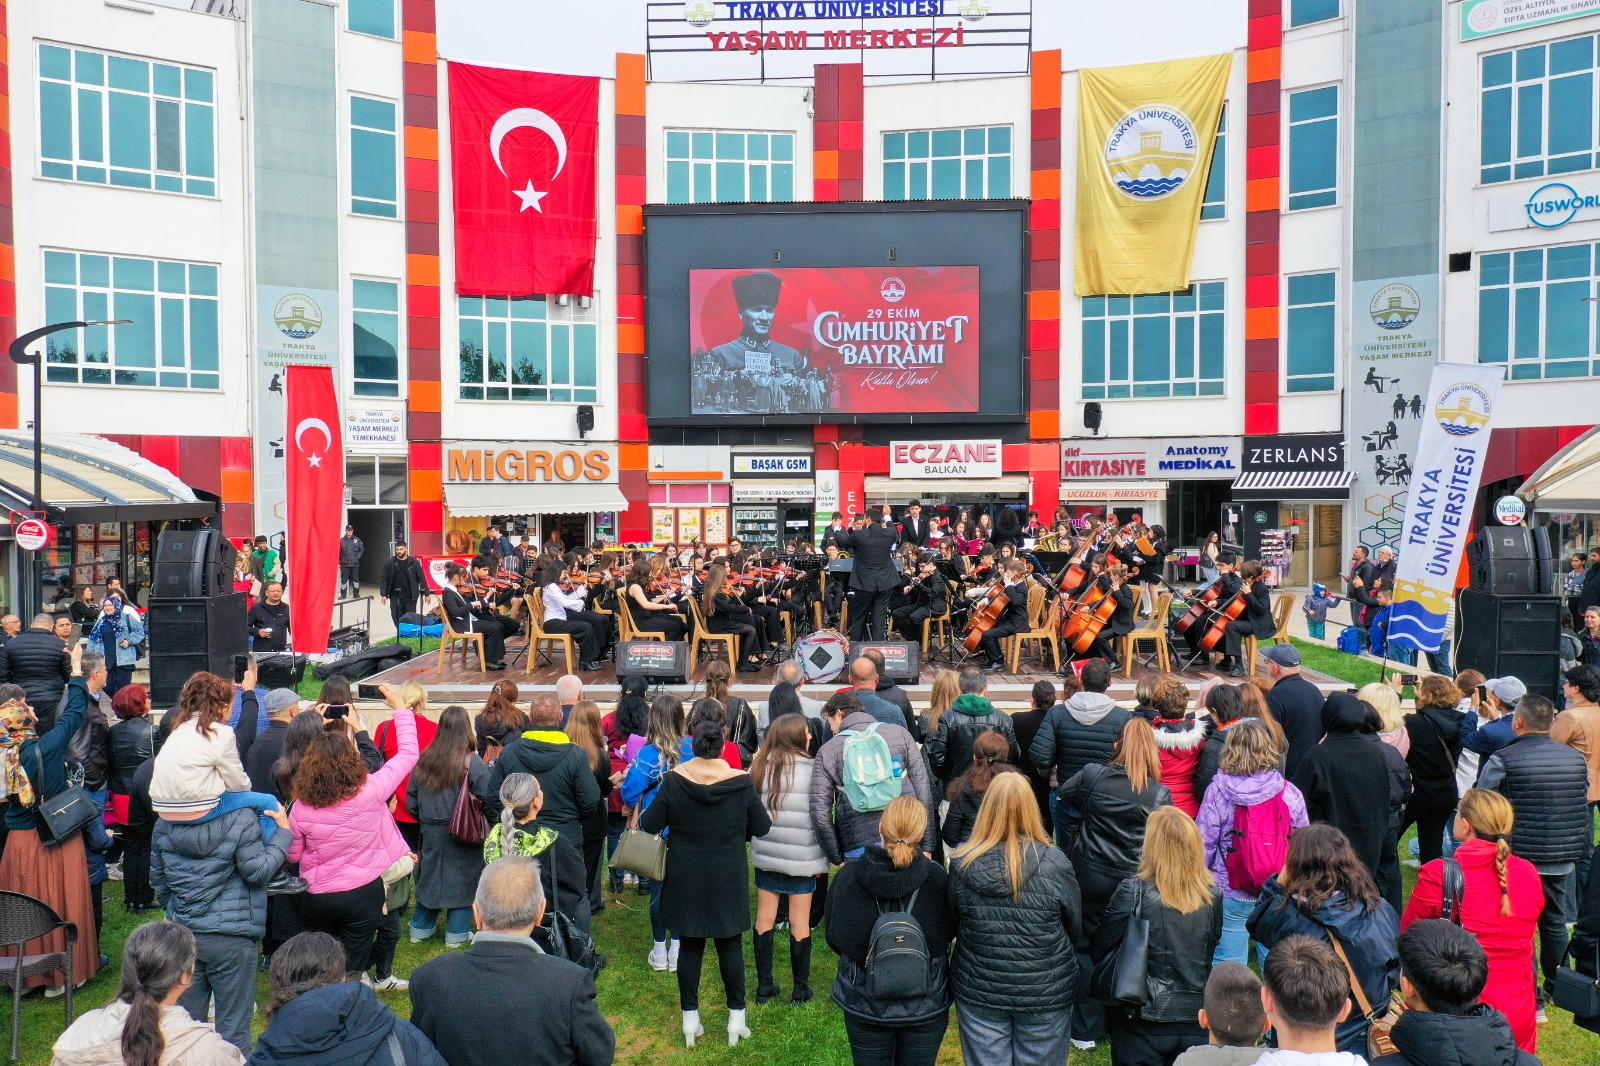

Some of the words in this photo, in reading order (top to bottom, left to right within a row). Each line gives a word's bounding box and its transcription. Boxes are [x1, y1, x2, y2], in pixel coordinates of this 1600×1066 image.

[726, 1, 807, 19] TRAKYA
[1503, 5, 1524, 15] ÖZEL
[1504, 15, 1525, 24] TIPTA
[1527, 5, 1569, 19] UZMANLIK
[706, 30, 807, 55] YAŞAM
[824, 22, 964, 49] MERKEZİ
[1109, 117, 1138, 152] TRAKYA
[1139, 109, 1195, 149] ÜNİVERSİTESİ
[1142, 138, 1160, 149] 1982
[867, 309, 883, 319] 29
[888, 306, 920, 319] EKİM
[1377, 333, 1412, 342] TRAKYA
[1364, 341, 1426, 352] ÜNİVERSİTESİ
[268, 350, 327, 360] ÜNİVERSİTESİ
[839, 344, 944, 369] BAYRAMI
[1359, 353, 1389, 361] YAŞAM
[1391, 350, 1432, 359] MERKEZİ
[861, 371, 894, 390] Kutlu
[896, 371, 937, 389] Olsun!
[1439, 386, 1459, 405] TRAKYA
[894, 443, 998, 463] ECZANE
[1166, 445, 1229, 457] Anatomy
[1250, 446, 1339, 464] ZERLANS
[751, 459, 784, 471] BAŞAK
[786, 459, 807, 470] GSM
[924, 465, 967, 474] BALKAN
[1159, 457, 1236, 470] MEDİKAL
[1067, 490, 1108, 498] UCUZLUK
[1409, 468, 1442, 545] TRAKYA
[1425, 447, 1476, 577] ÜNİVERSİTESİ
[1498, 504, 1524, 513] Medikal
